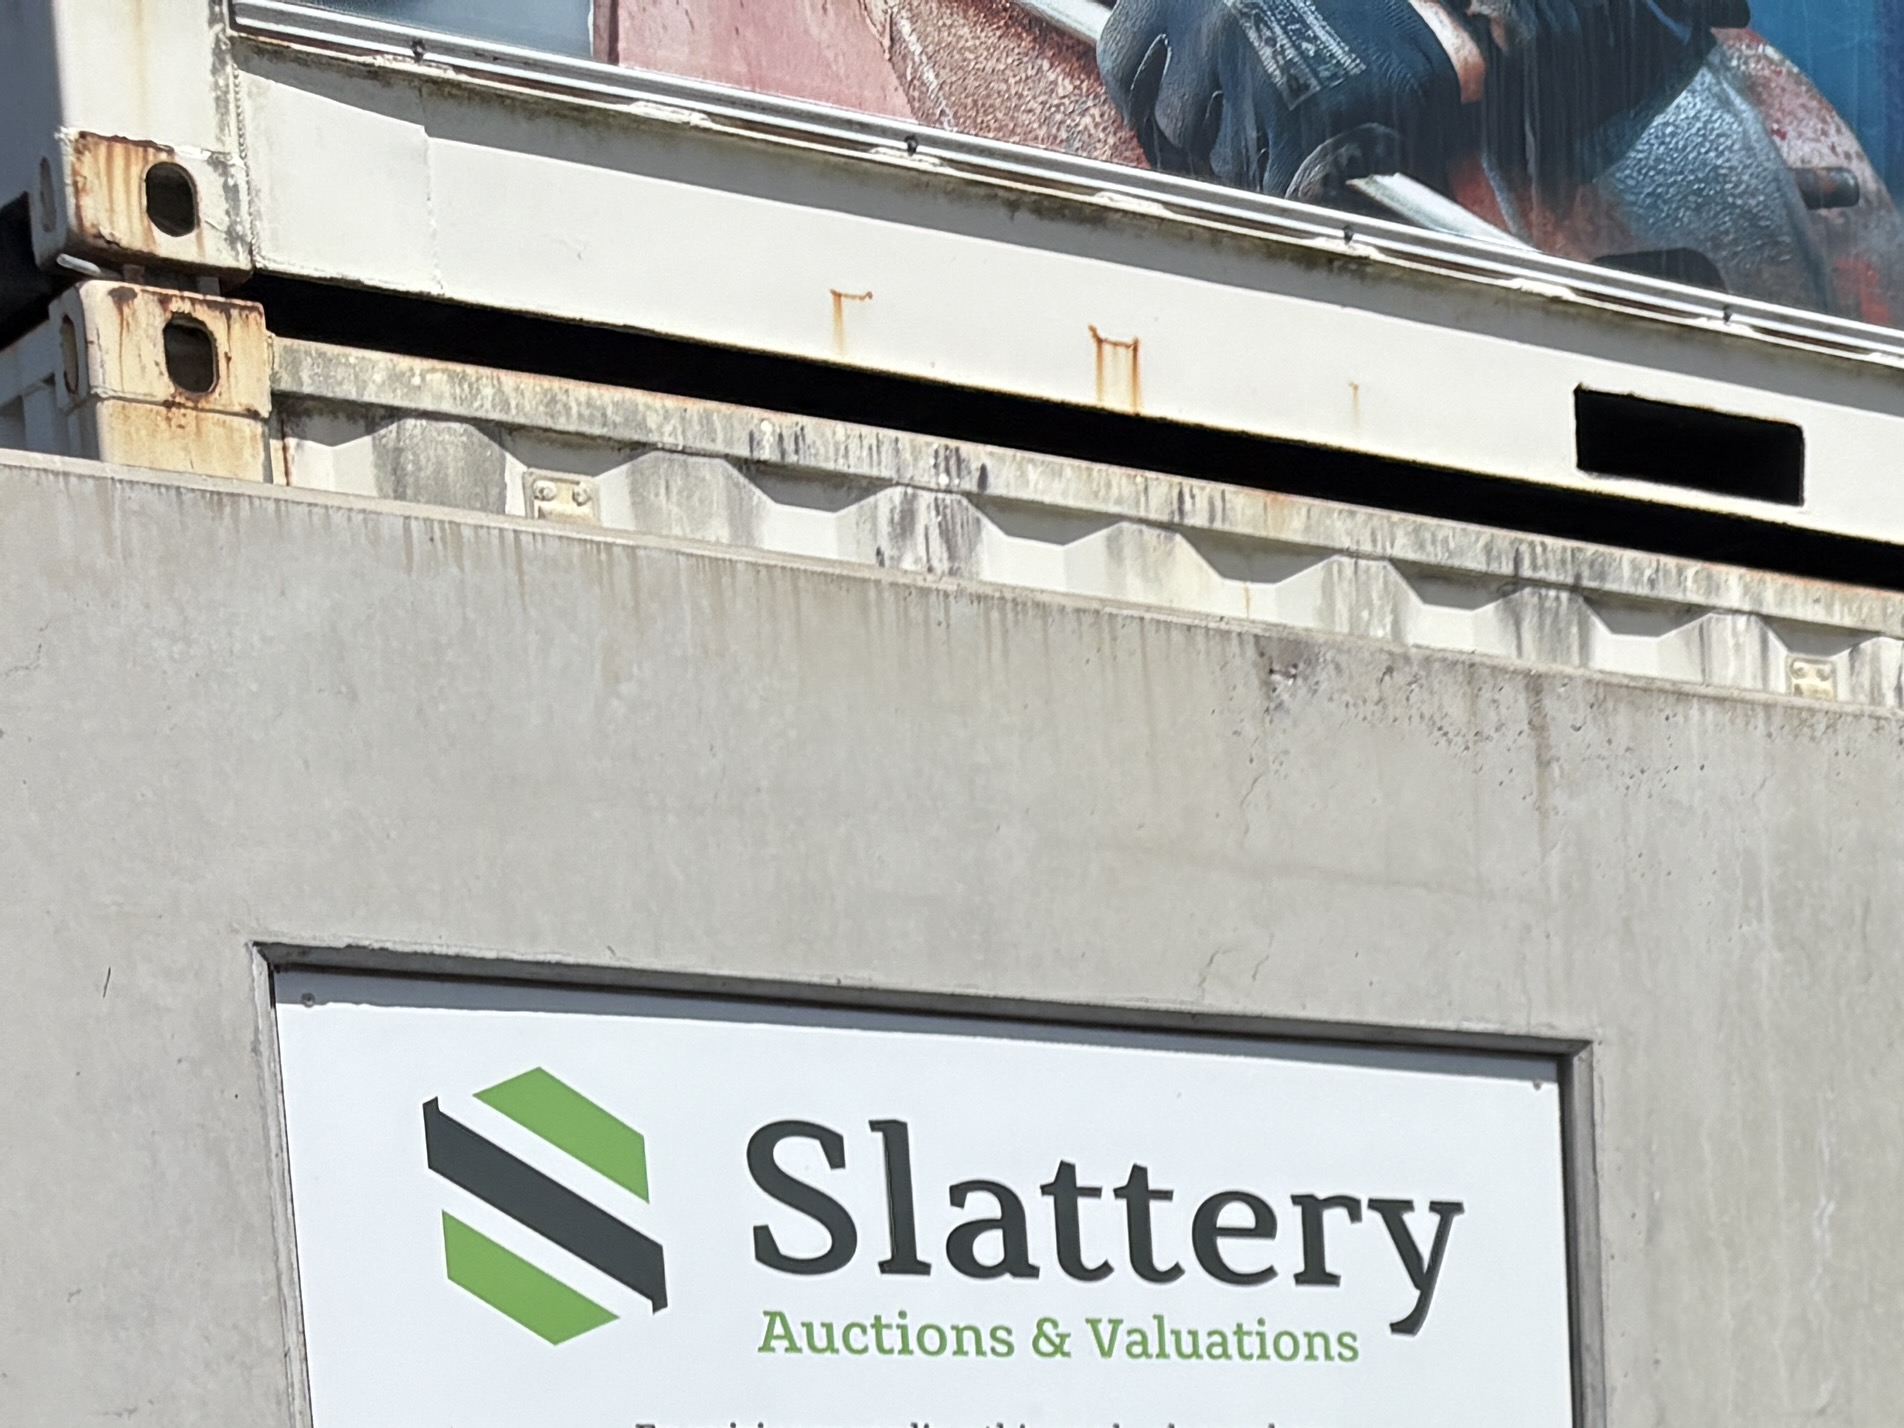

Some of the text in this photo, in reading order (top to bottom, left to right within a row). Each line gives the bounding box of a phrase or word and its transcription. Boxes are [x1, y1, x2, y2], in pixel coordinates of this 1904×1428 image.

[746, 1119, 1464, 1336] Slattery
[757, 1311, 1359, 1362] Auctions & Valuations
